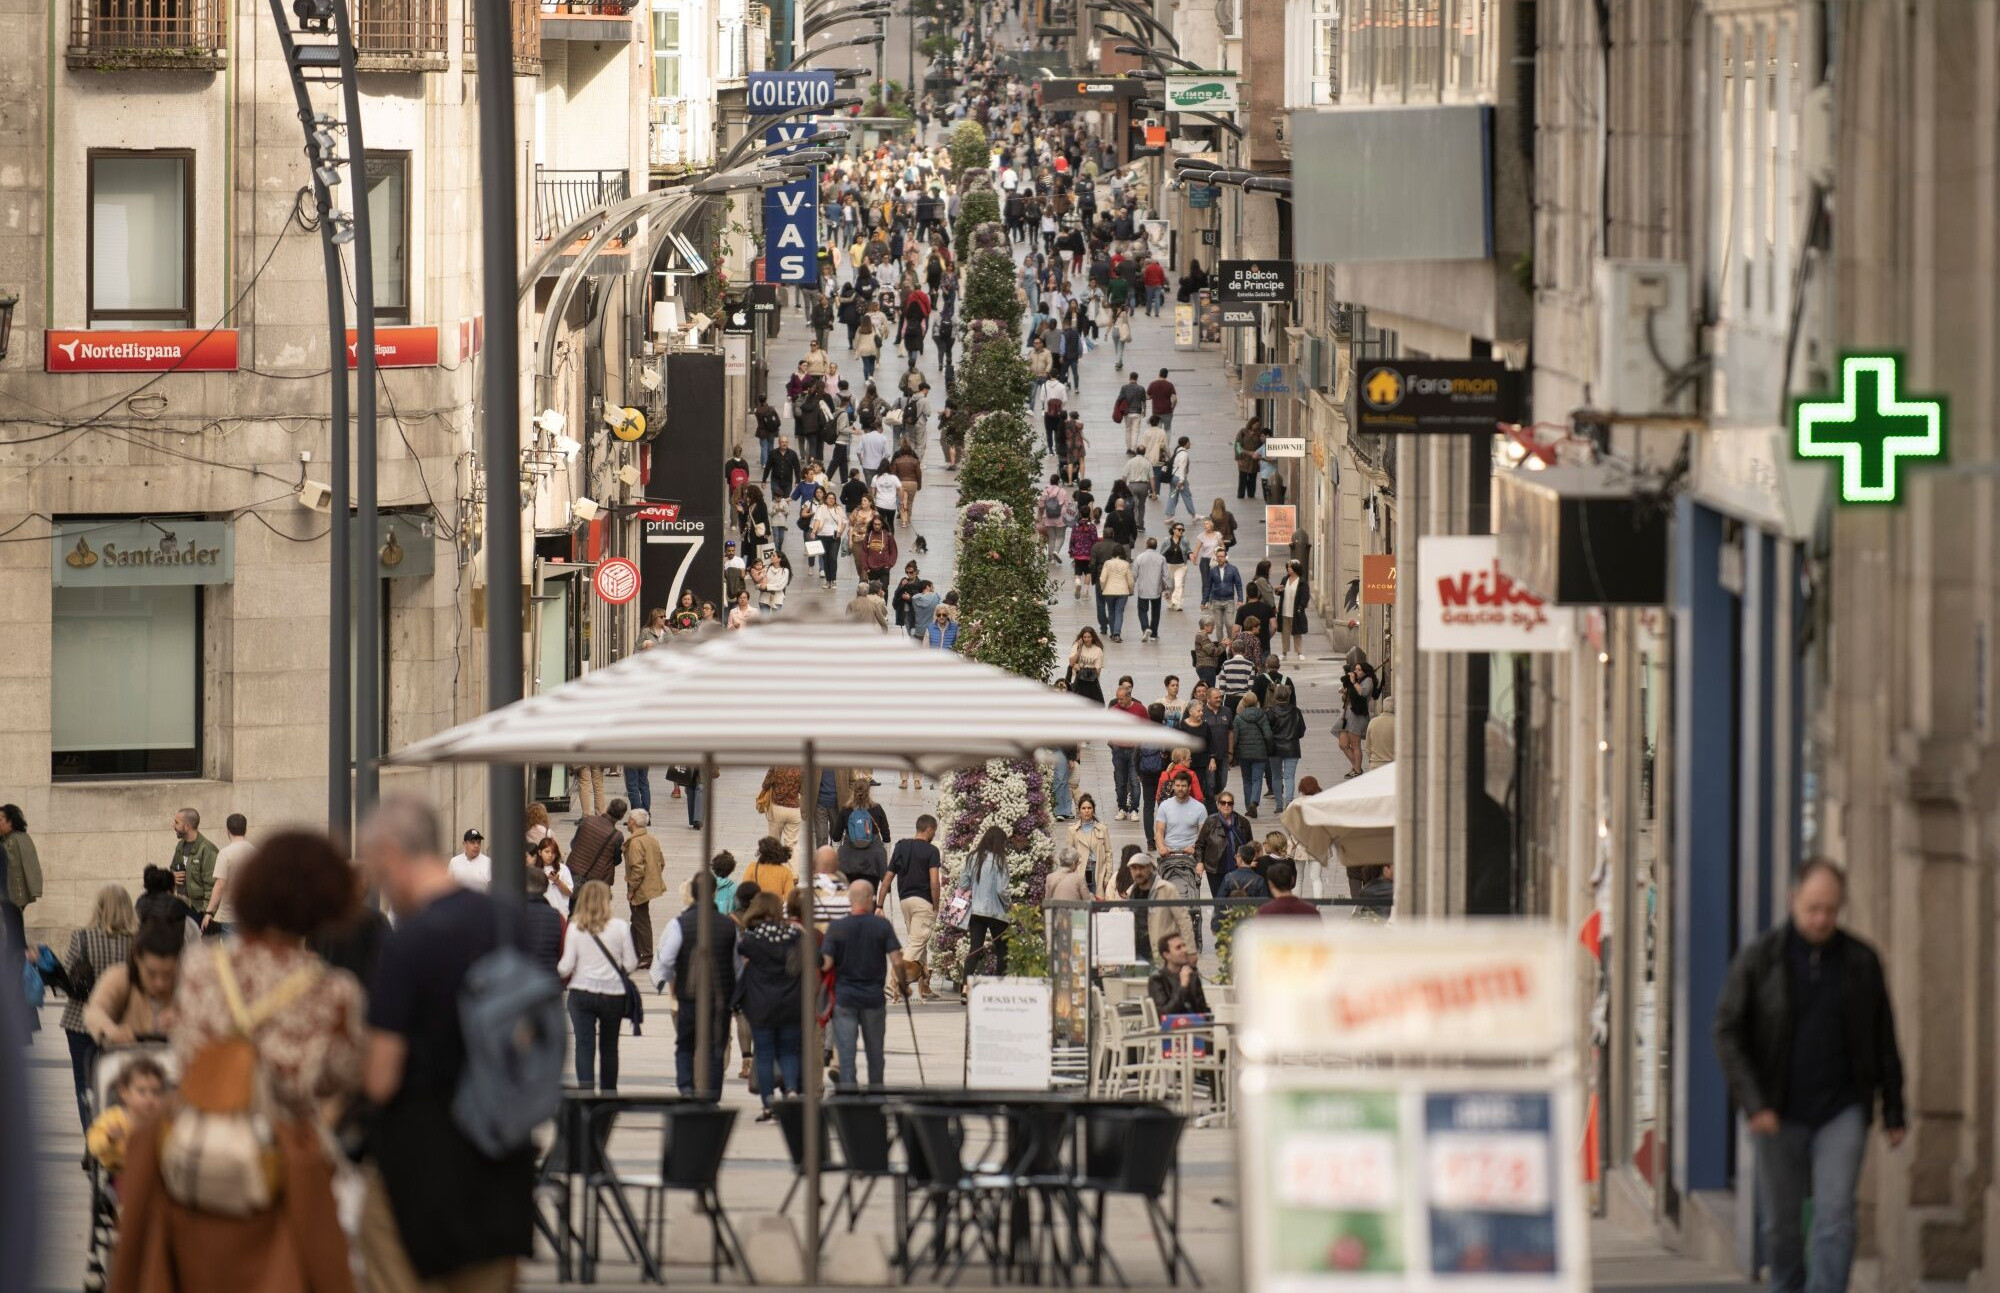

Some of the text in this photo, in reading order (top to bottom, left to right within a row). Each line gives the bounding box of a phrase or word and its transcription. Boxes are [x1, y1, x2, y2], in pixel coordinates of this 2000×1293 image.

[752, 80, 830, 106] COLEXIO
[777, 126, 806, 280] VVAS
[1234, 270, 1279, 280] El Balcón
[1228, 280, 1242, 290] de
[80, 343, 182, 361] NorteHispana
[1406, 374, 1499, 395] Faramon
[1267, 443, 1305, 451] BROWNIE
[646, 519, 705, 533] príncipe
[102, 540, 221, 568] Santander
[646, 535, 705, 620] 7
